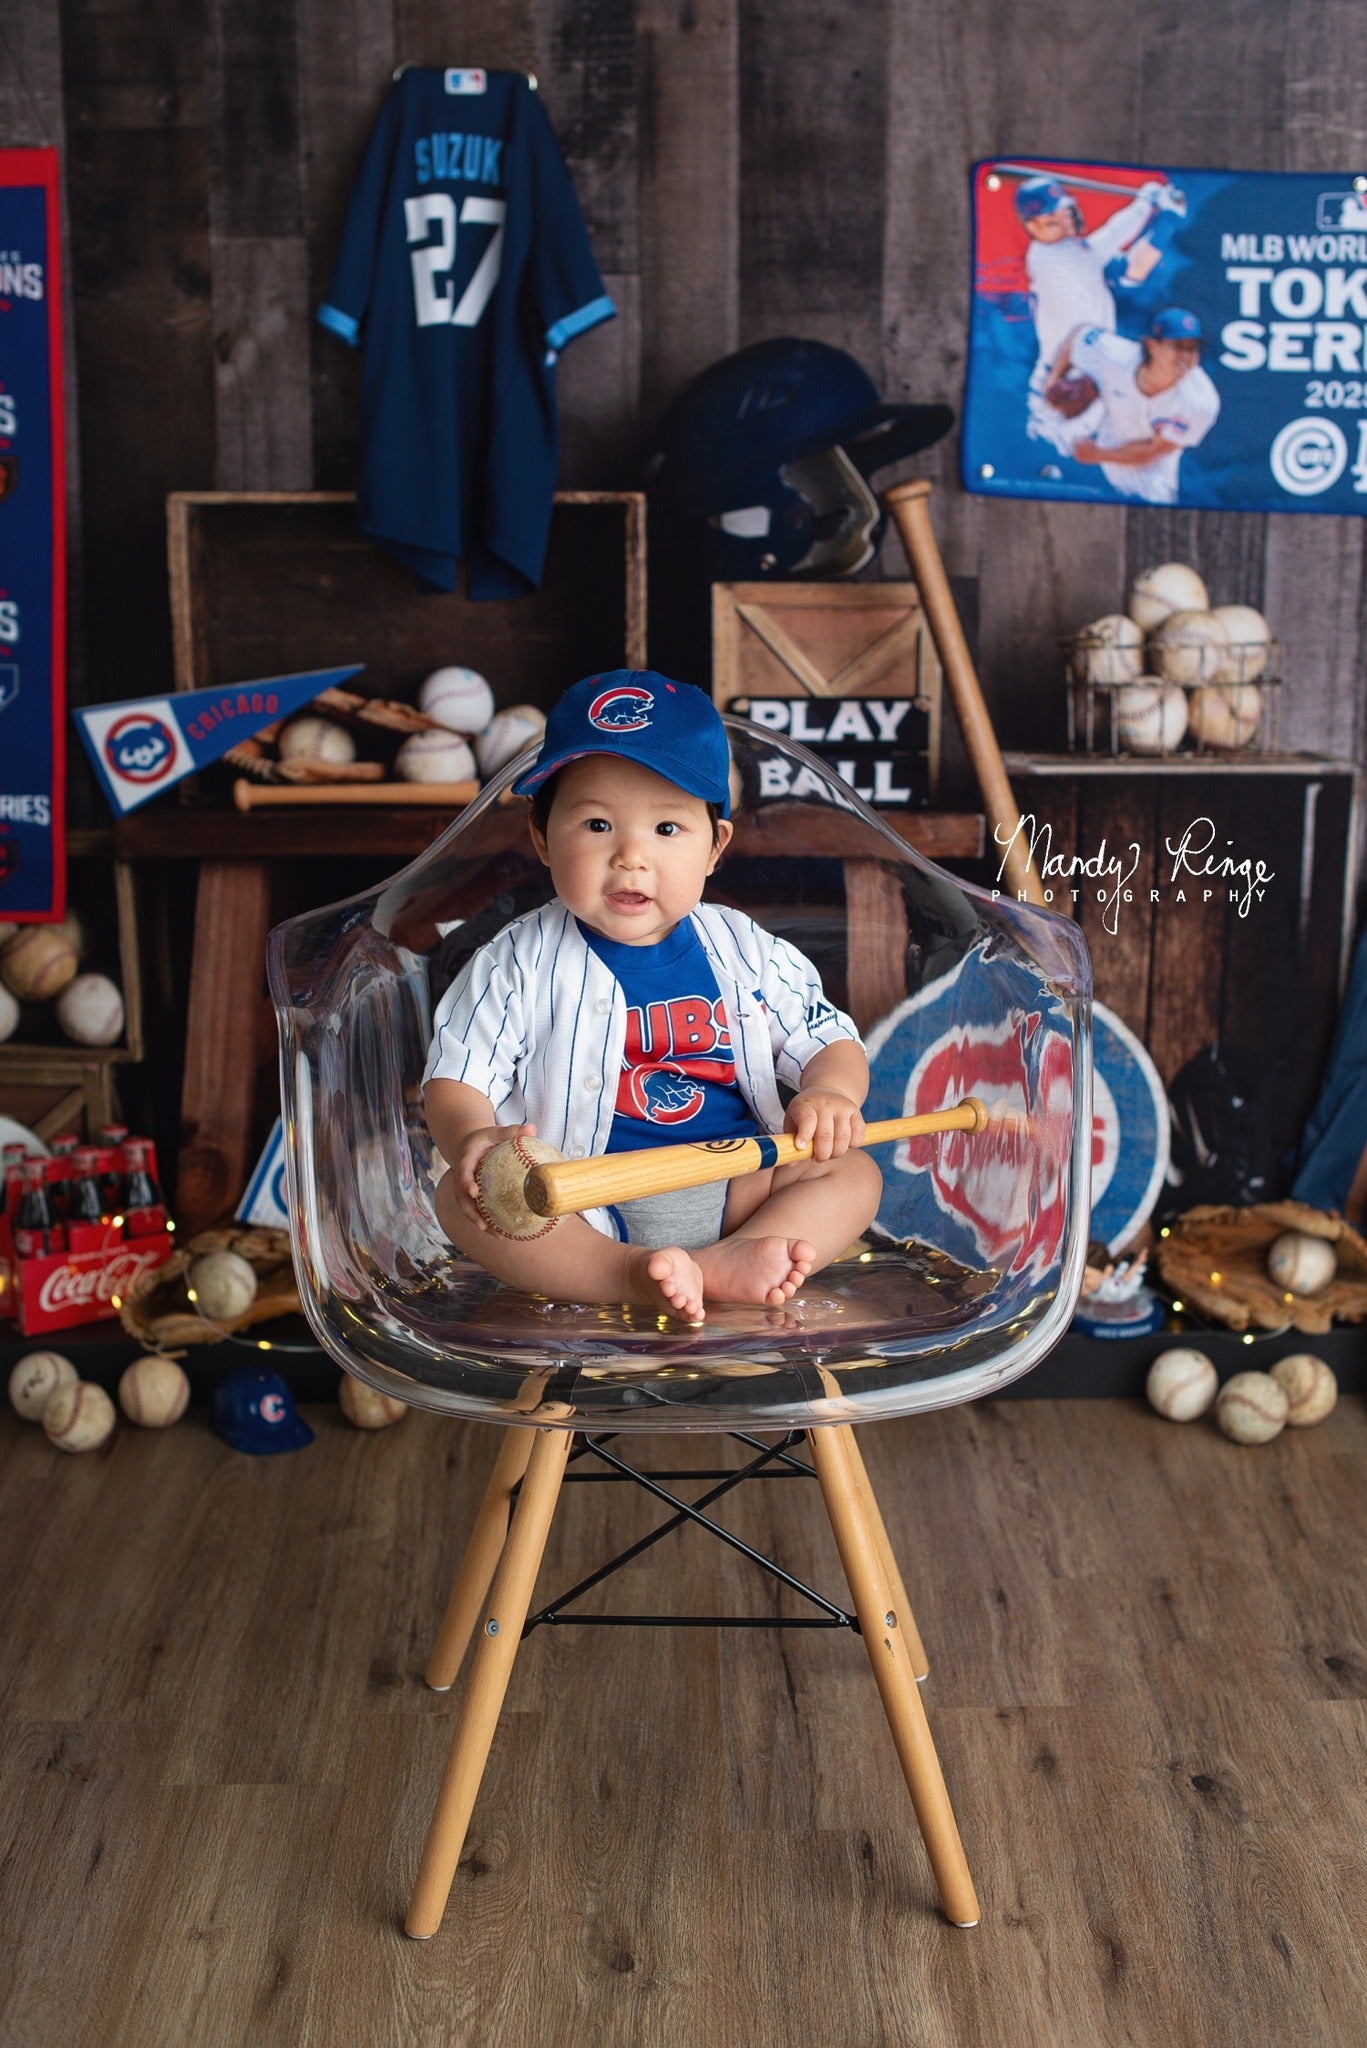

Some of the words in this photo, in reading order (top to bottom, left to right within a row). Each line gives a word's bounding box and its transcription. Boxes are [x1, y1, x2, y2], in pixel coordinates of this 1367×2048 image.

[414, 132, 502, 185] SUZUK
[404, 193, 506, 327] 27
[1221, 233, 1284, 262] MLB
[1225, 267, 1367, 319] TOK
[187, 693, 279, 741] CHICAGO
[750, 701, 912, 742] PLAY
[758, 756, 911, 803] BALL
[260, 1394, 285, 1422] C
